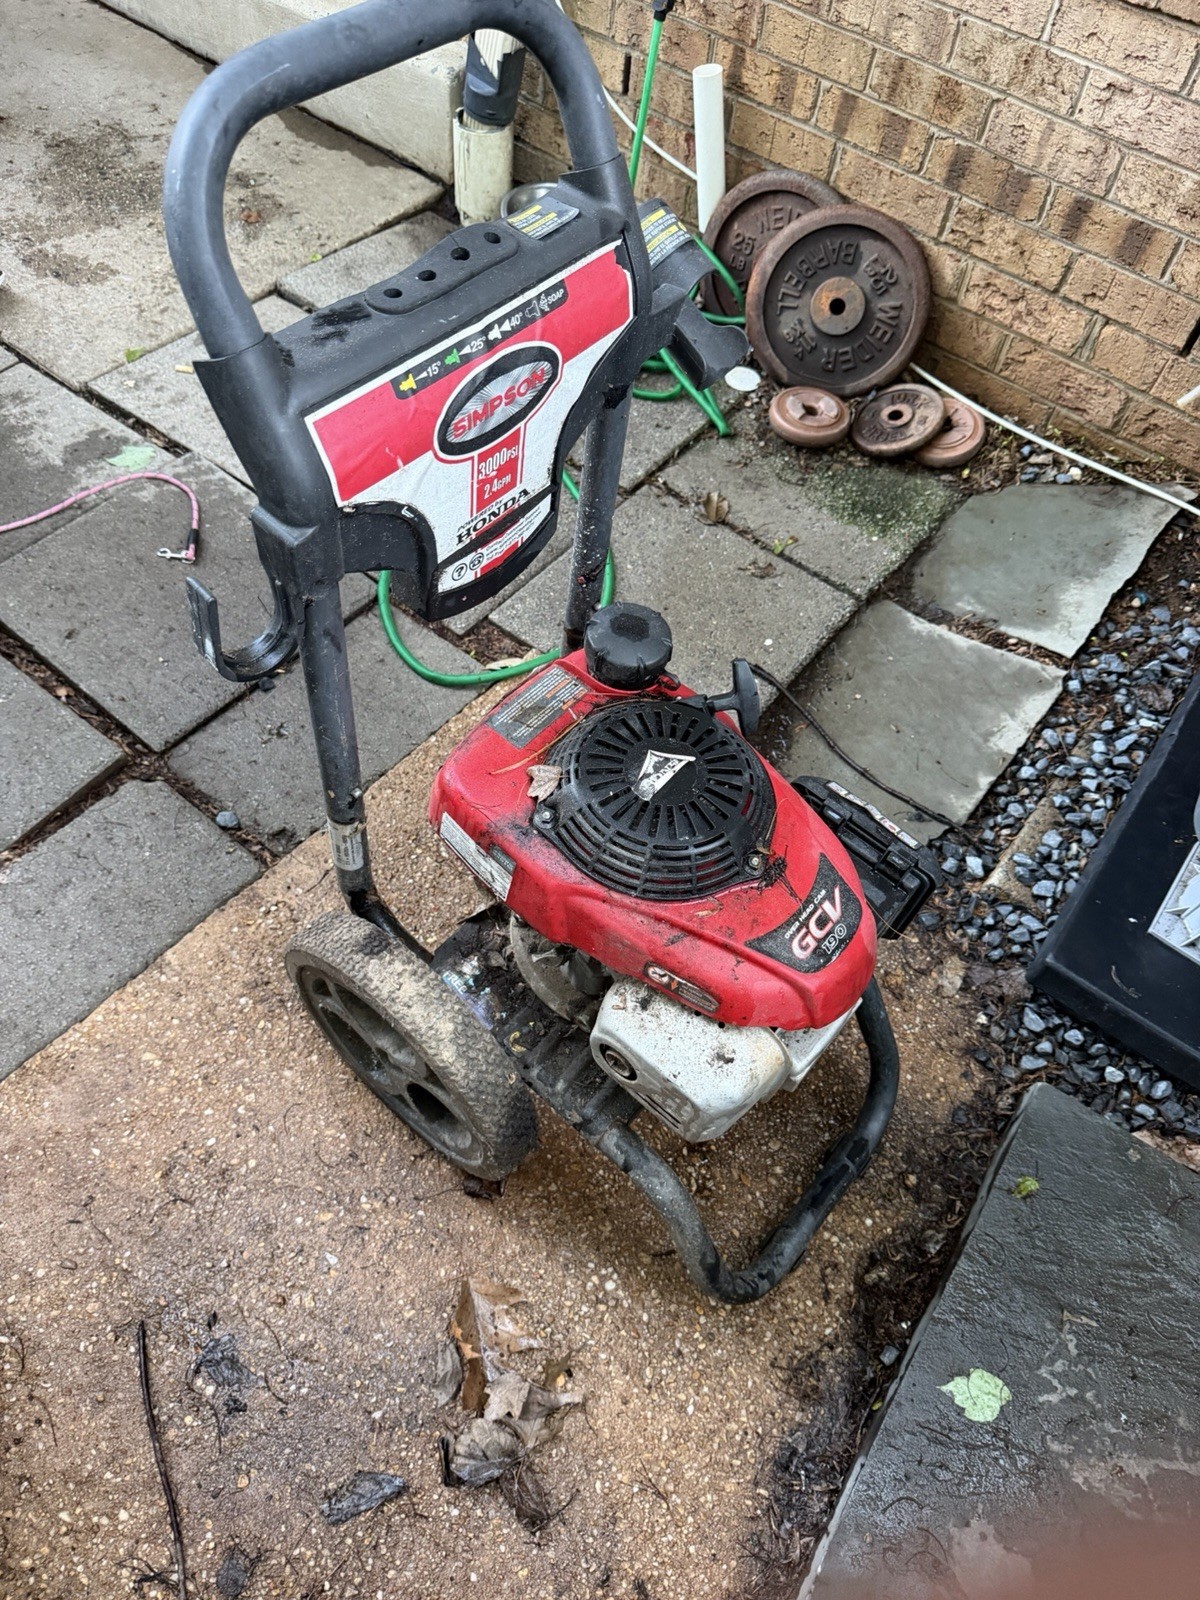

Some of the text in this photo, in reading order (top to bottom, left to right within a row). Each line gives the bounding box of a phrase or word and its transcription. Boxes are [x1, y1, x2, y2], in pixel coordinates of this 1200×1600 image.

[731, 231, 756, 256] 25
[752, 205, 802, 234] WEI
[730, 254, 746, 271] LB
[777, 239, 860, 316] BARBELL
[868, 263, 898, 296] 25
[426, 288, 565, 377] 15° 25° 40° SOAP
[821, 300, 904, 373] WEIDER
[452, 367, 546, 439] SIMPSON
[456, 488, 531, 546] HONDA
[784, 889, 827, 939] OVER HEAD CAM
[791, 884, 842, 960] GCV
[821, 922, 848, 954] 190
